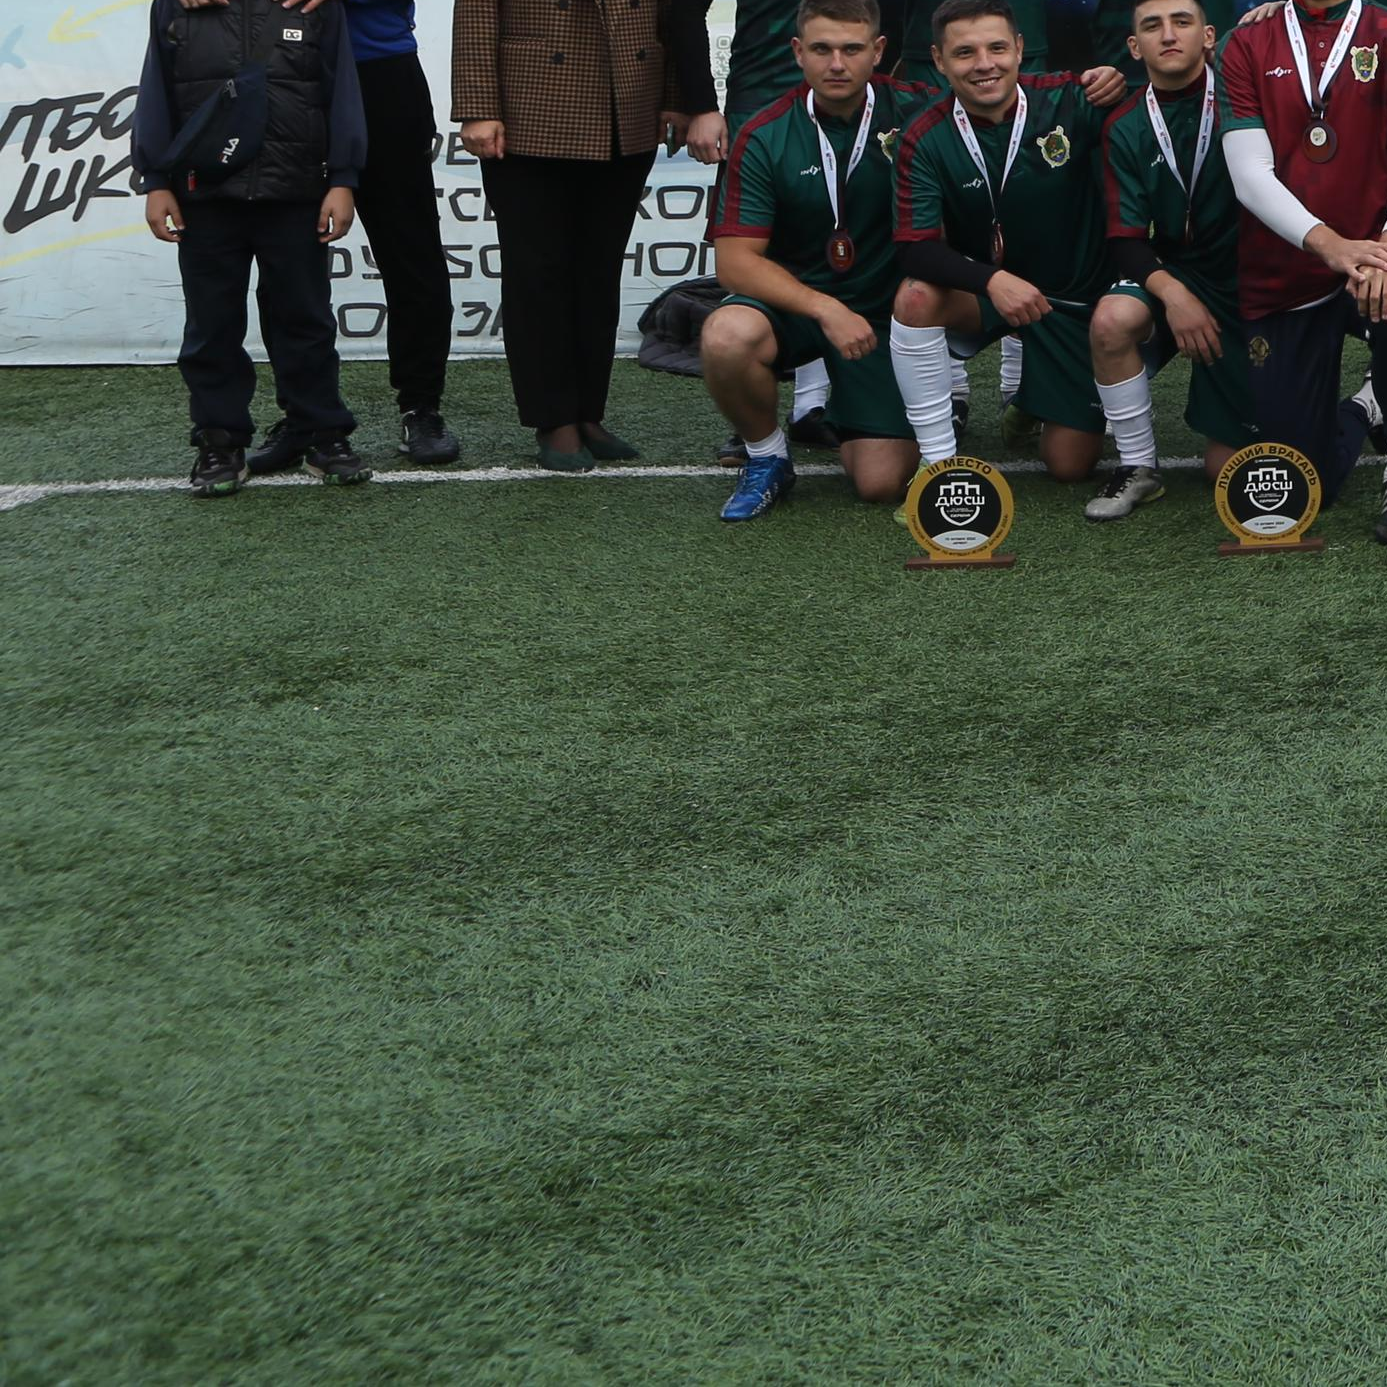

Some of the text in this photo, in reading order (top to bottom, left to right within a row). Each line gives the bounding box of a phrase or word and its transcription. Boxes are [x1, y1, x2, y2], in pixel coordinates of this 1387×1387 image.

[221, 137, 240, 164] FILA
[943, 457, 992, 475] МЕСТО
[1218, 444, 1318, 490] ЛУЧШИЙ ВРАТАРЬ
[1244, 480, 1293, 493] ДЮСШ
[935, 496, 985, 507] ДЮСШ
